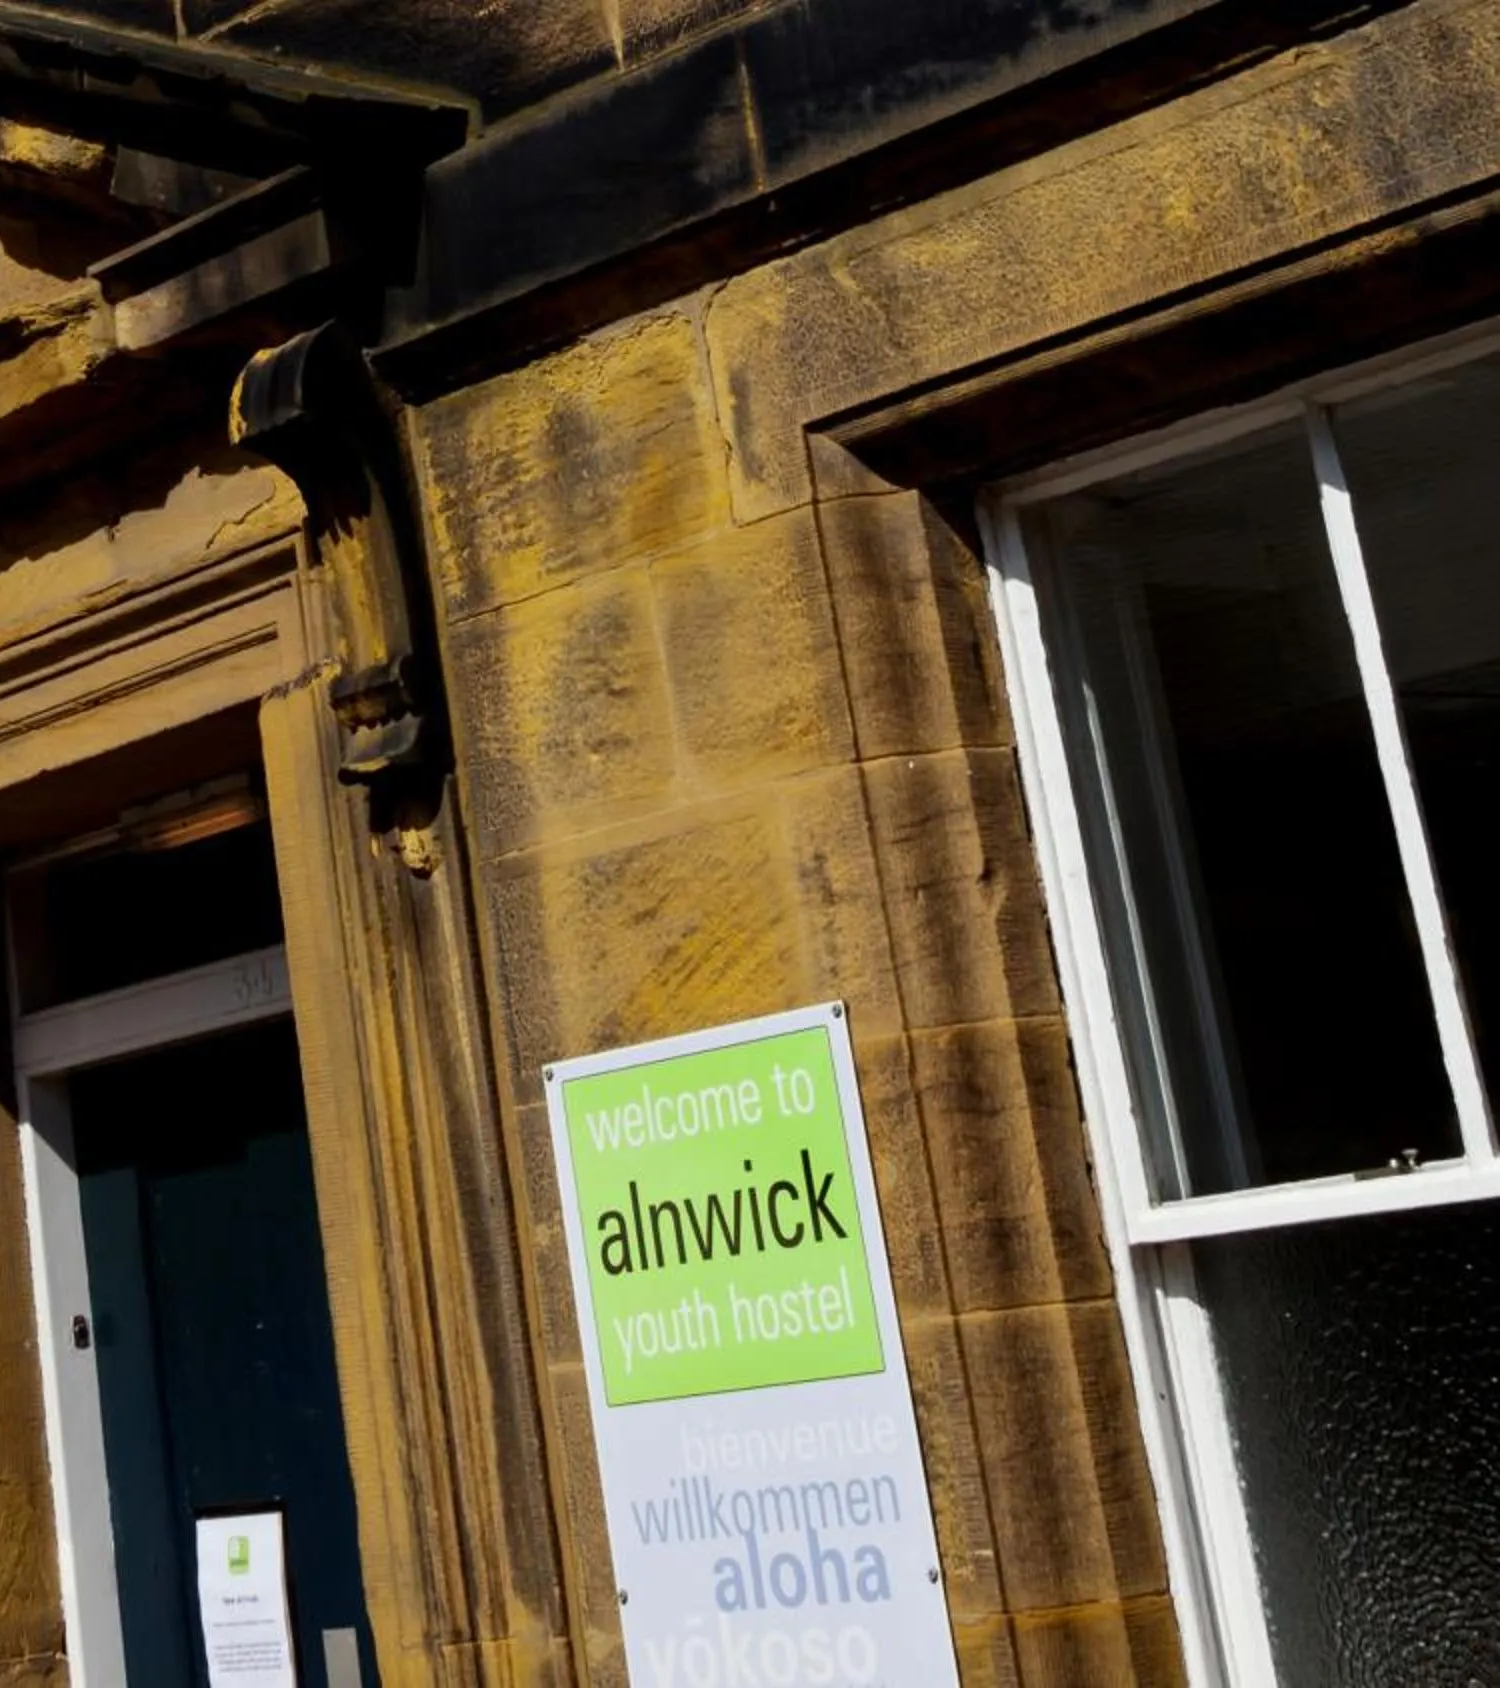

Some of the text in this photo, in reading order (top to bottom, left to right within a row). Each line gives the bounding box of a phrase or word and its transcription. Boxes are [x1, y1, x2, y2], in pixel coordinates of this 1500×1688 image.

[585, 1063, 816, 1154] welcome to
[599, 1148, 848, 1276] alnwick
[613, 1266, 857, 1374] youth hostel
[680, 1410, 901, 1473] bienvenue
[631, 1472, 901, 1546] willkommen
[712, 1529, 892, 1613] aloha
